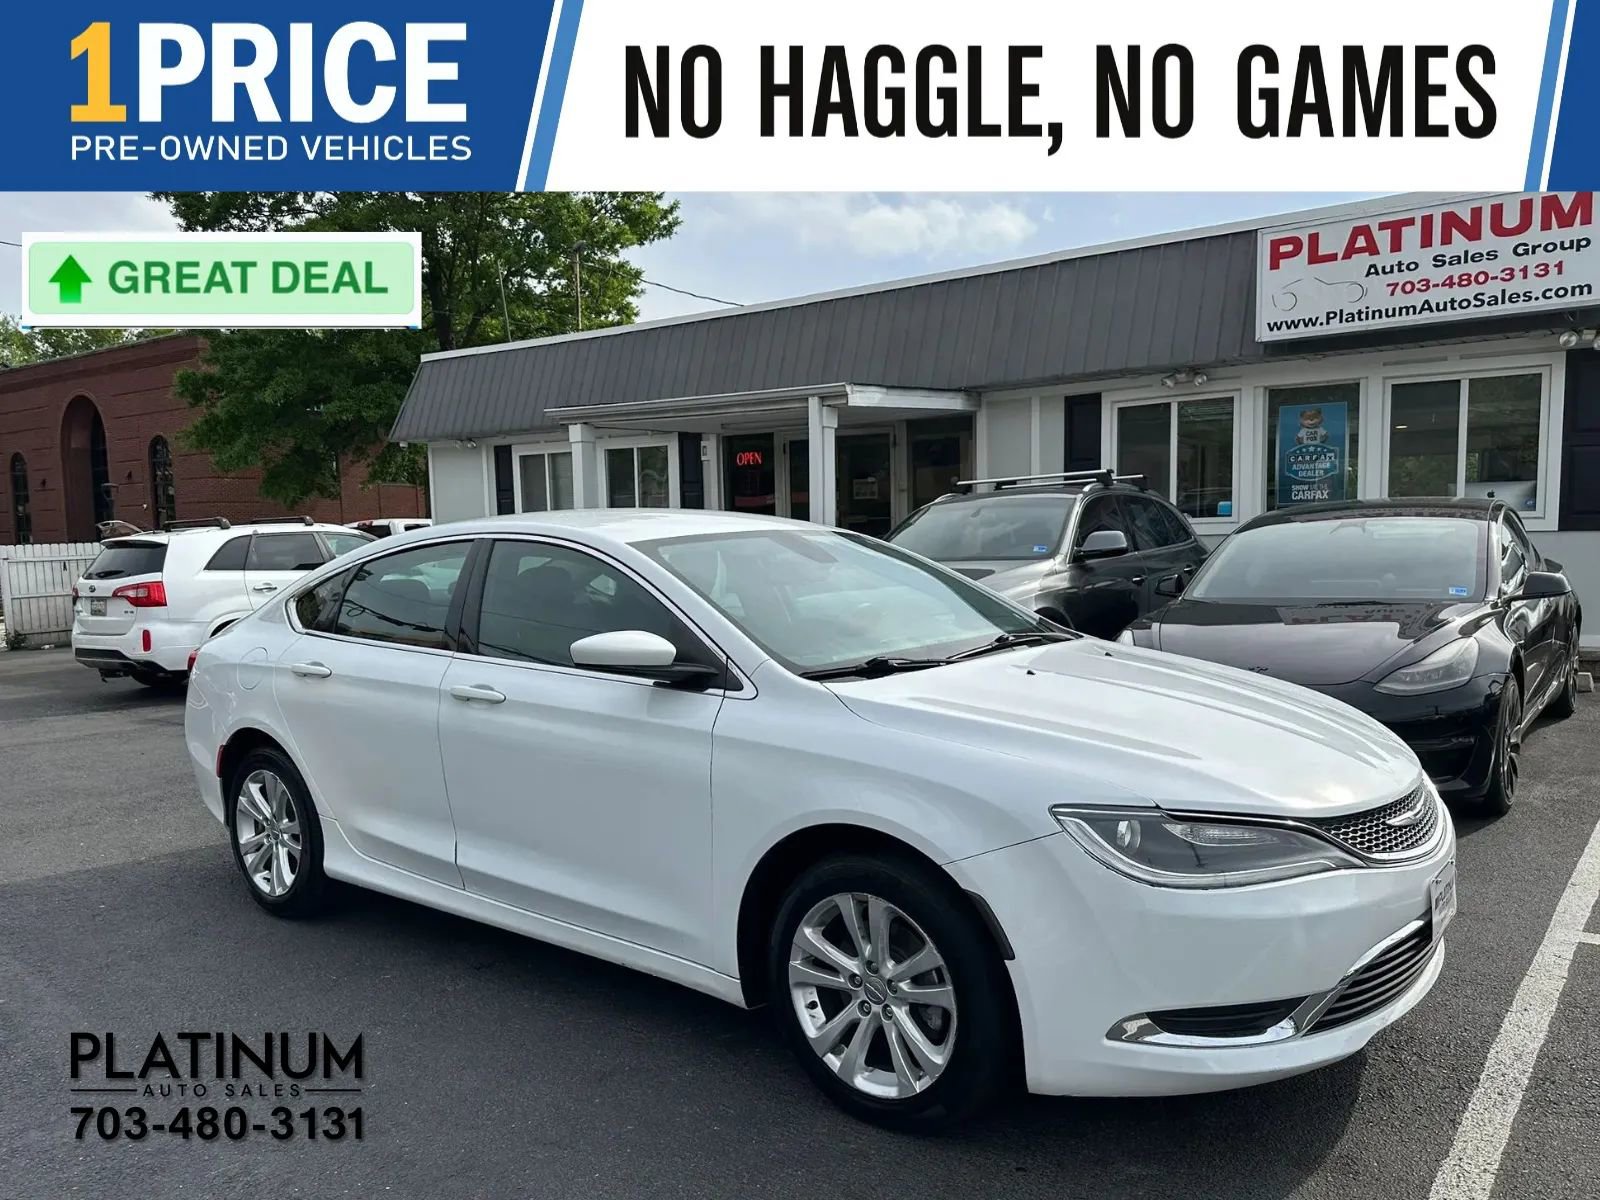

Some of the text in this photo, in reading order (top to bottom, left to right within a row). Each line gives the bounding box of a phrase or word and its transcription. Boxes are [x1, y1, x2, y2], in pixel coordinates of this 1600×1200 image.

[1269, 191, 1593, 271] PLATINUM
[1364, 236, 1592, 278] Auto Sales Group
[1385, 260, 1564, 297] 703-480-3131
[1266, 282, 1593, 332] www.PlatinumAutoSales.com
[736, 451, 763, 466] OPEN
[1292, 462, 1330, 470] ADVANTAGE
[1299, 469, 1325, 477] DEALER
[1292, 490, 1329, 500] CARFAX
